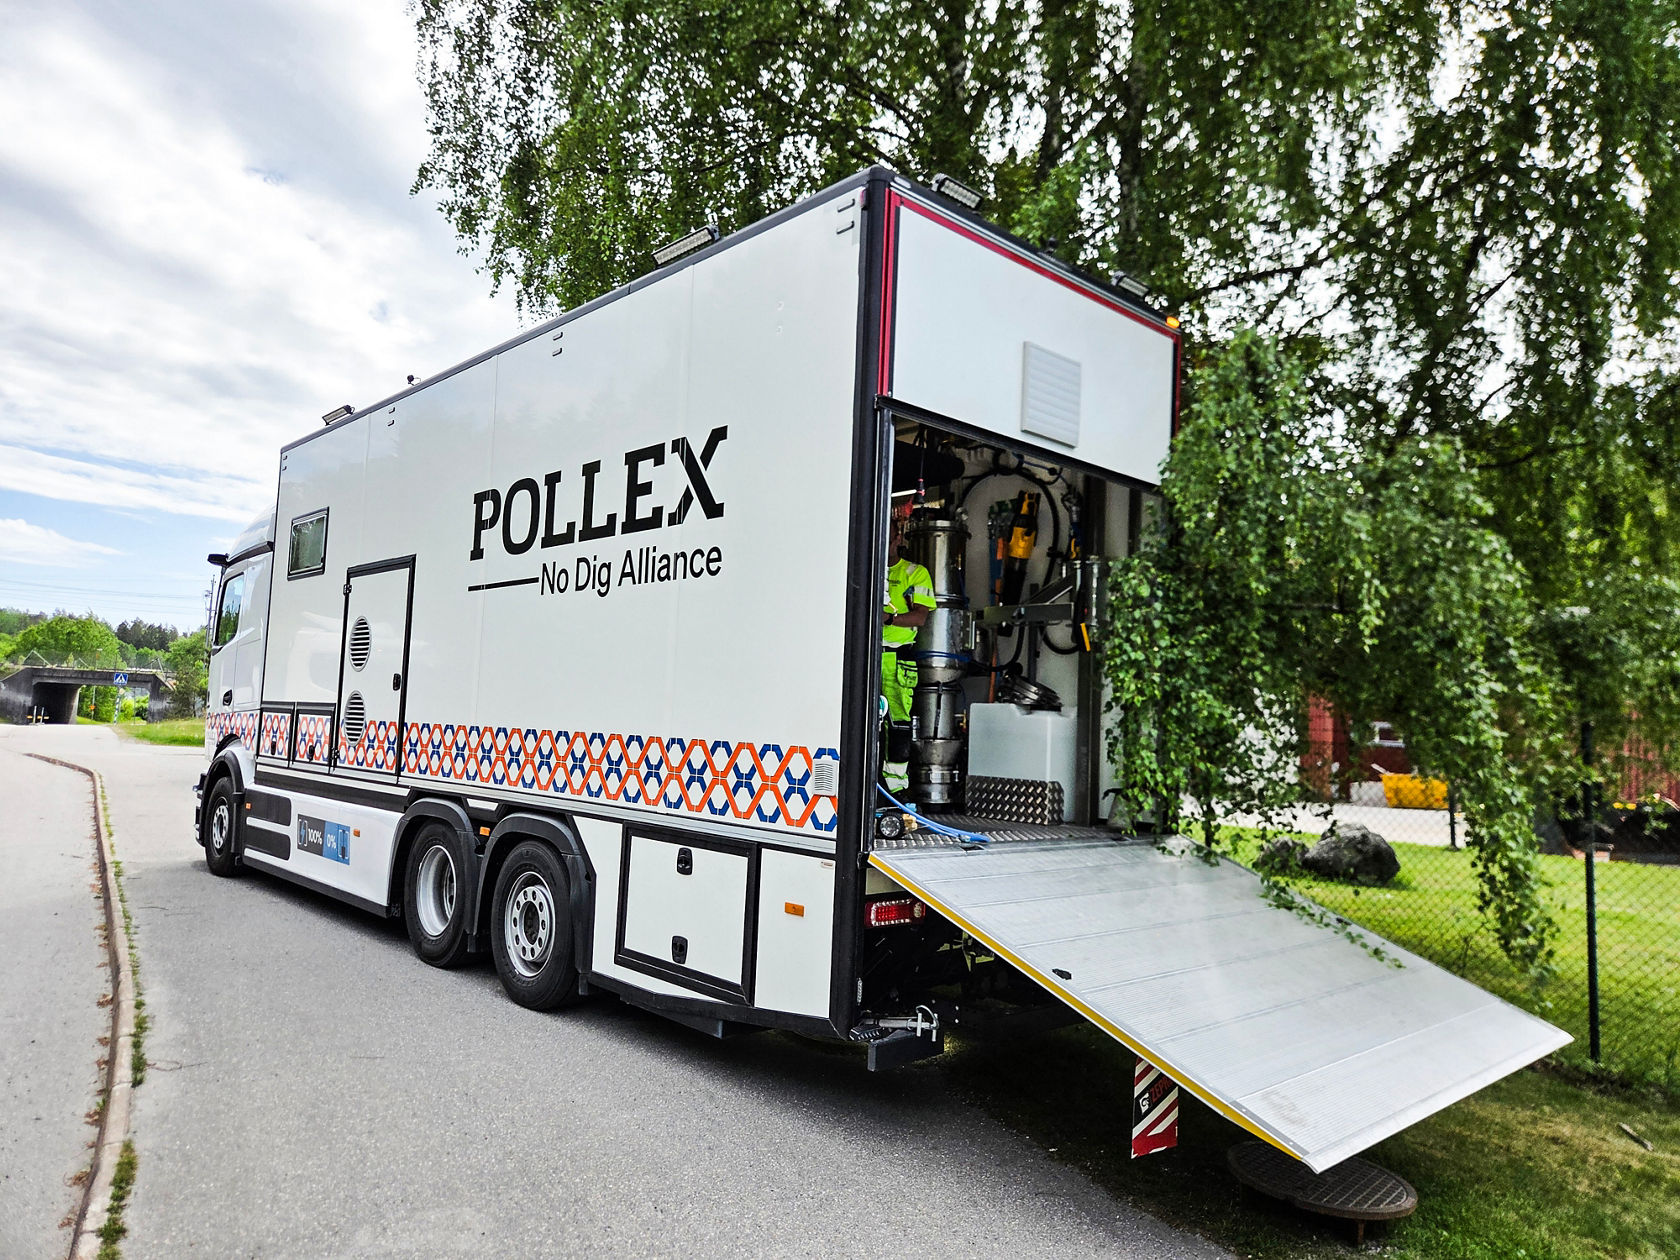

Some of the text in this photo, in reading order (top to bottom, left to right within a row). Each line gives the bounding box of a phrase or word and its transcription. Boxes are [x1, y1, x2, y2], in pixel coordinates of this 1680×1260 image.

[470, 425, 728, 561] POLLEX
[540, 545, 723, 598] No Dig Alliance
[308, 828, 322, 844] 100%
[327, 834, 336, 848] 0%
[1150, 1075, 1174, 1102] ZEPR
